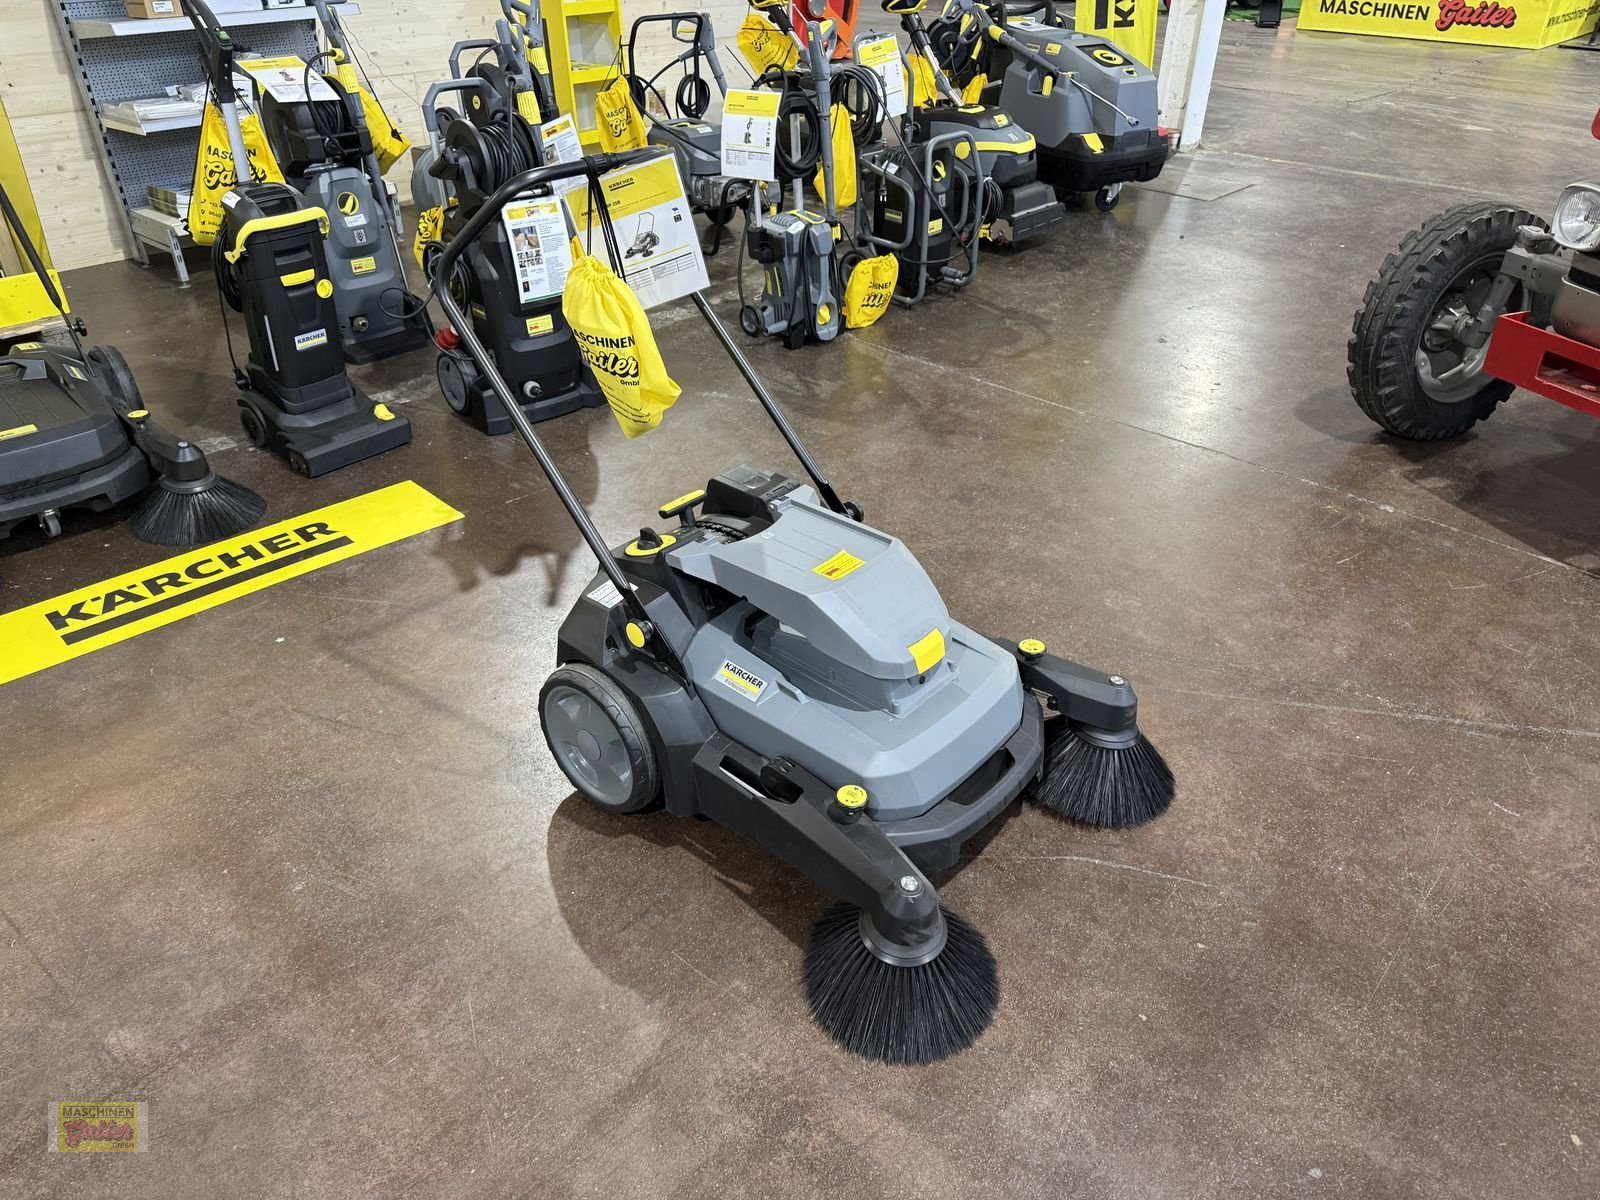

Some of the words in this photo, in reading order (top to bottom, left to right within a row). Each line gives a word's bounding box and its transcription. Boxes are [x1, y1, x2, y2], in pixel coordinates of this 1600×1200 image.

[1319, 0, 1430, 20] MASCHINEN
[1435, 0, 1518, 31] Gailer
[44, 521, 342, 632] KÄRCHER
[724, 661, 764, 689] KÄRCHER
